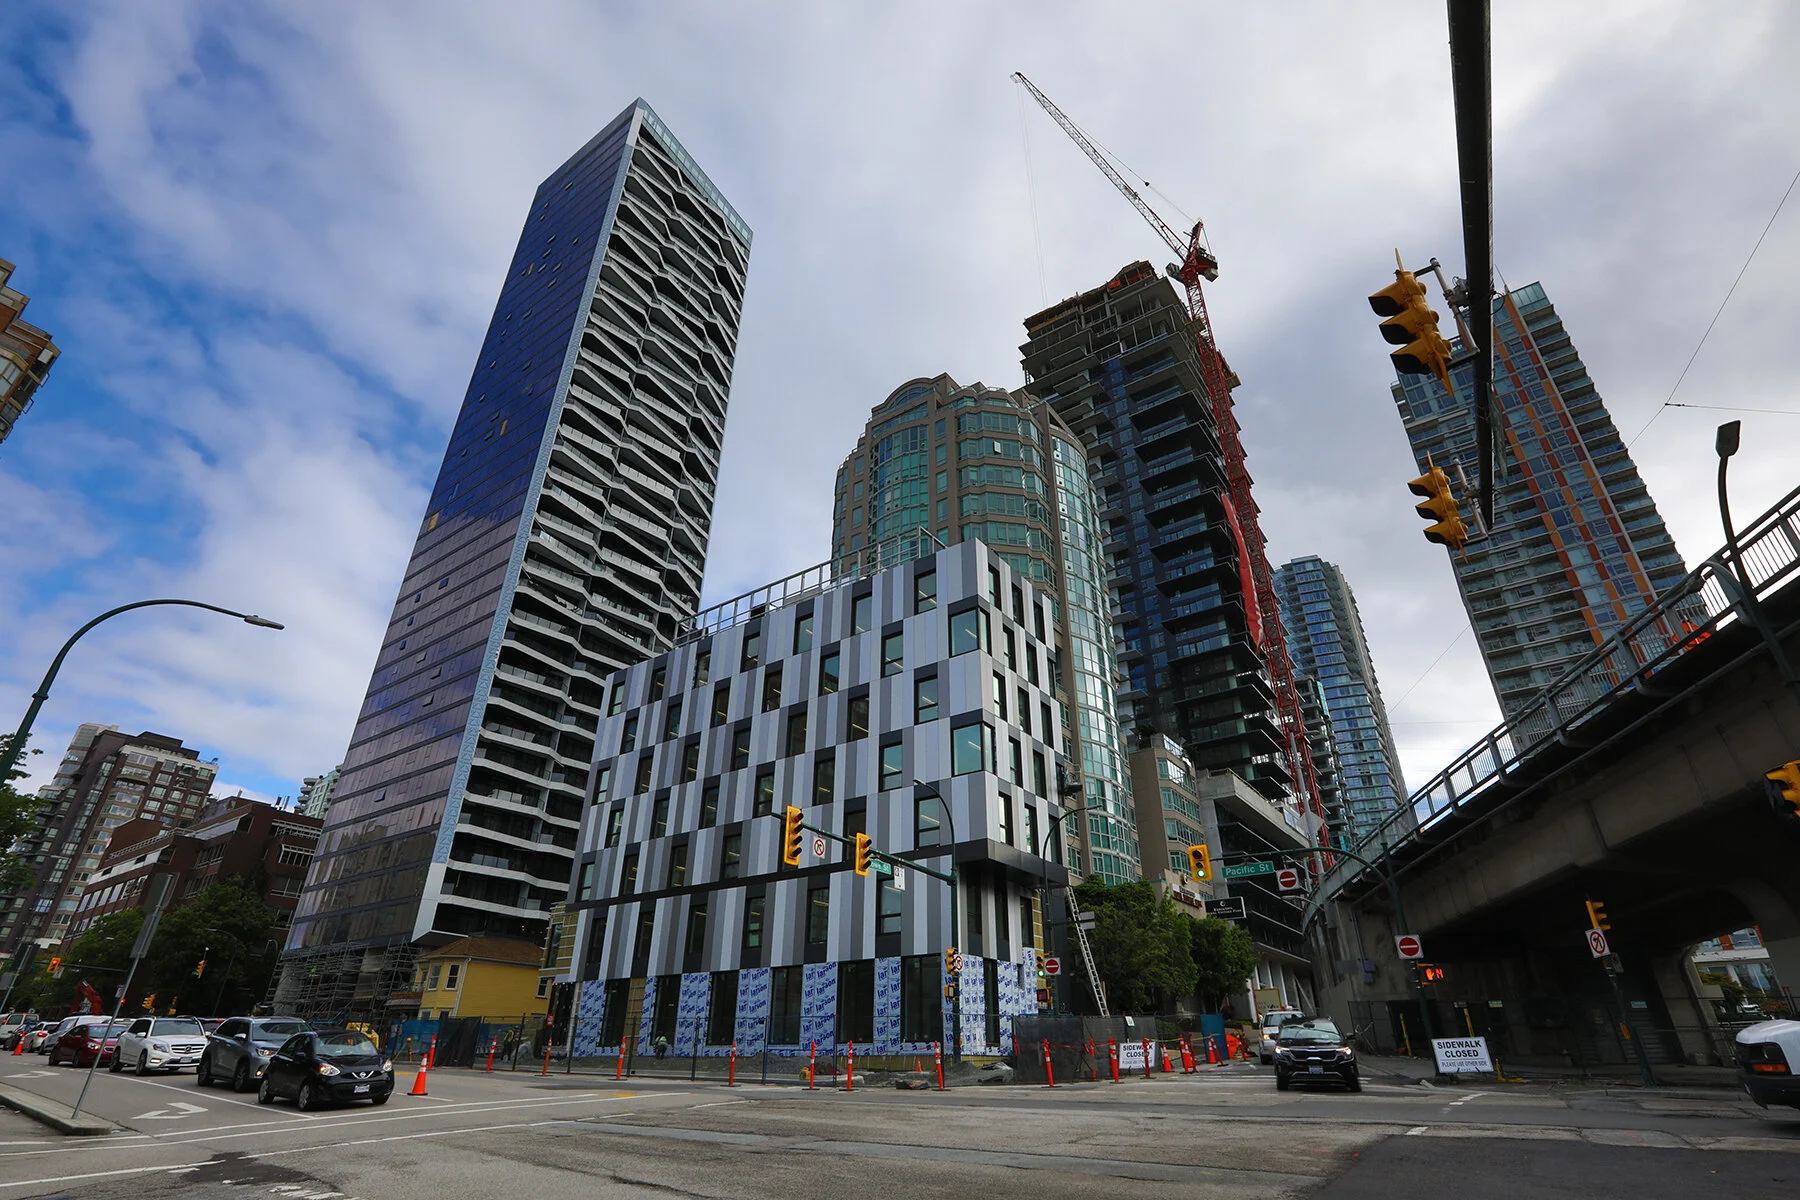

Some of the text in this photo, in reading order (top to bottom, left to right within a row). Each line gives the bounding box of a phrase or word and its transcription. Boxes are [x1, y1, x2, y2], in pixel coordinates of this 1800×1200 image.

[1226, 862, 1270, 876] Pacific St
[752, 968, 768, 980] larson
[817, 962, 836, 979] larson
[750, 984, 767, 997] larson
[816, 978, 835, 995] larson
[749, 1000, 766, 1013] larson
[816, 995, 835, 1012] larson
[815, 1012, 834, 1030] larson
[1437, 1040, 1482, 1049] SIDEWALK
[1445, 1050, 1478, 1058] CLOSED
